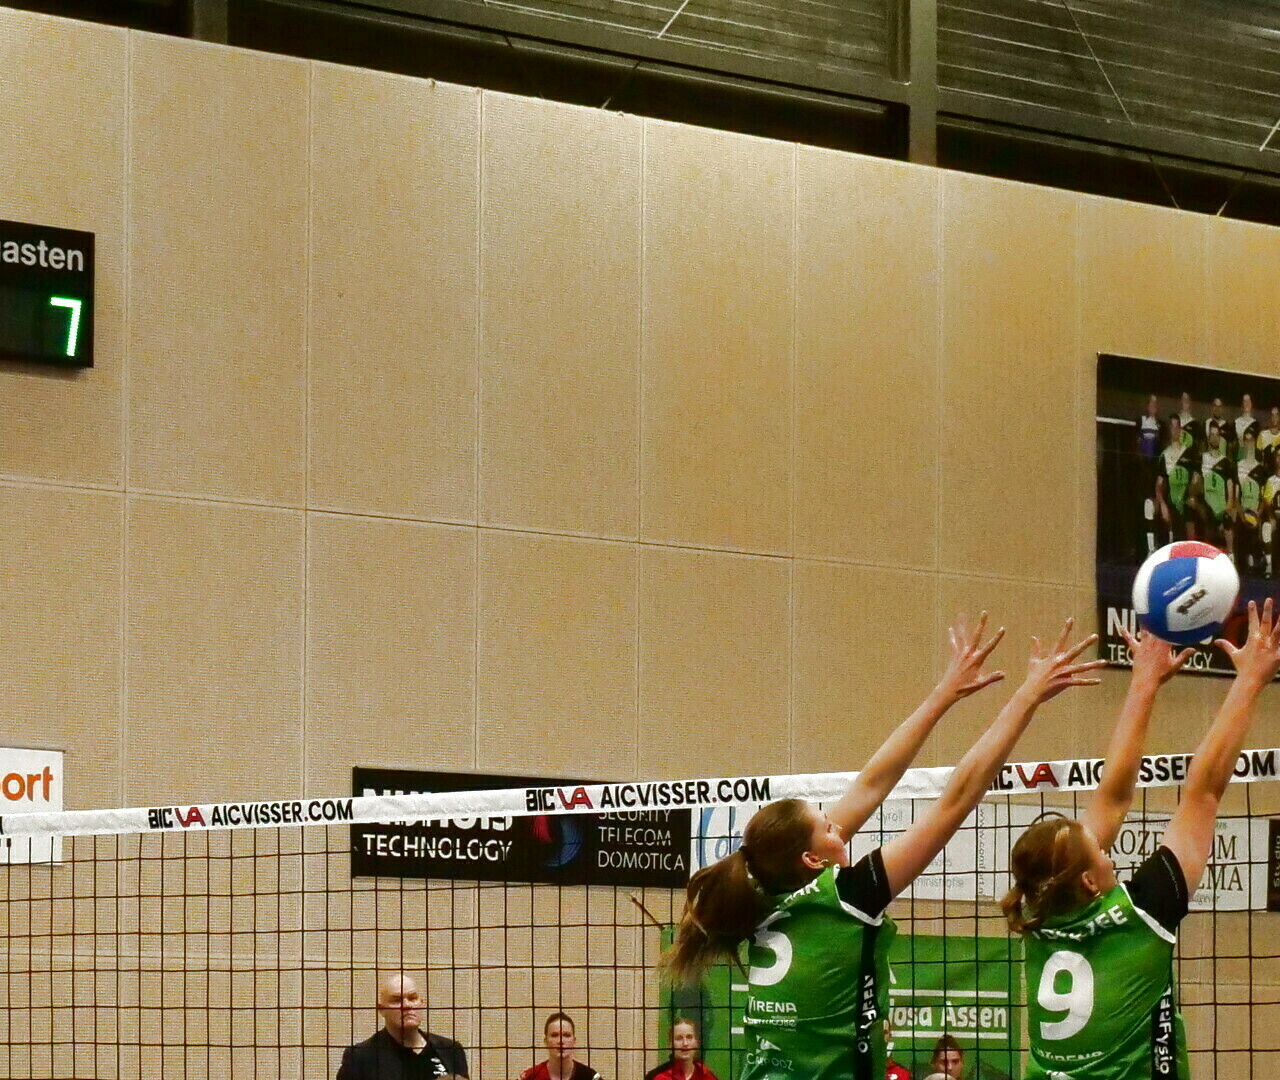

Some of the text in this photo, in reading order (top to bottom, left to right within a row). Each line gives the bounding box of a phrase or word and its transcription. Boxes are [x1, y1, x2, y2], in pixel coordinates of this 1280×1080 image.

[50, 296, 82, 357] 7
[600, 777, 772, 808] AICVISSER.COM
[211, 800, 353, 827] AICVISSER.COM
[362, 833, 513, 863] TECHNOLOGY
[597, 850, 685, 872] DOMOTICA
[1037, 950, 1094, 1040] 9
[941, 1000, 1007, 1029] Assen
